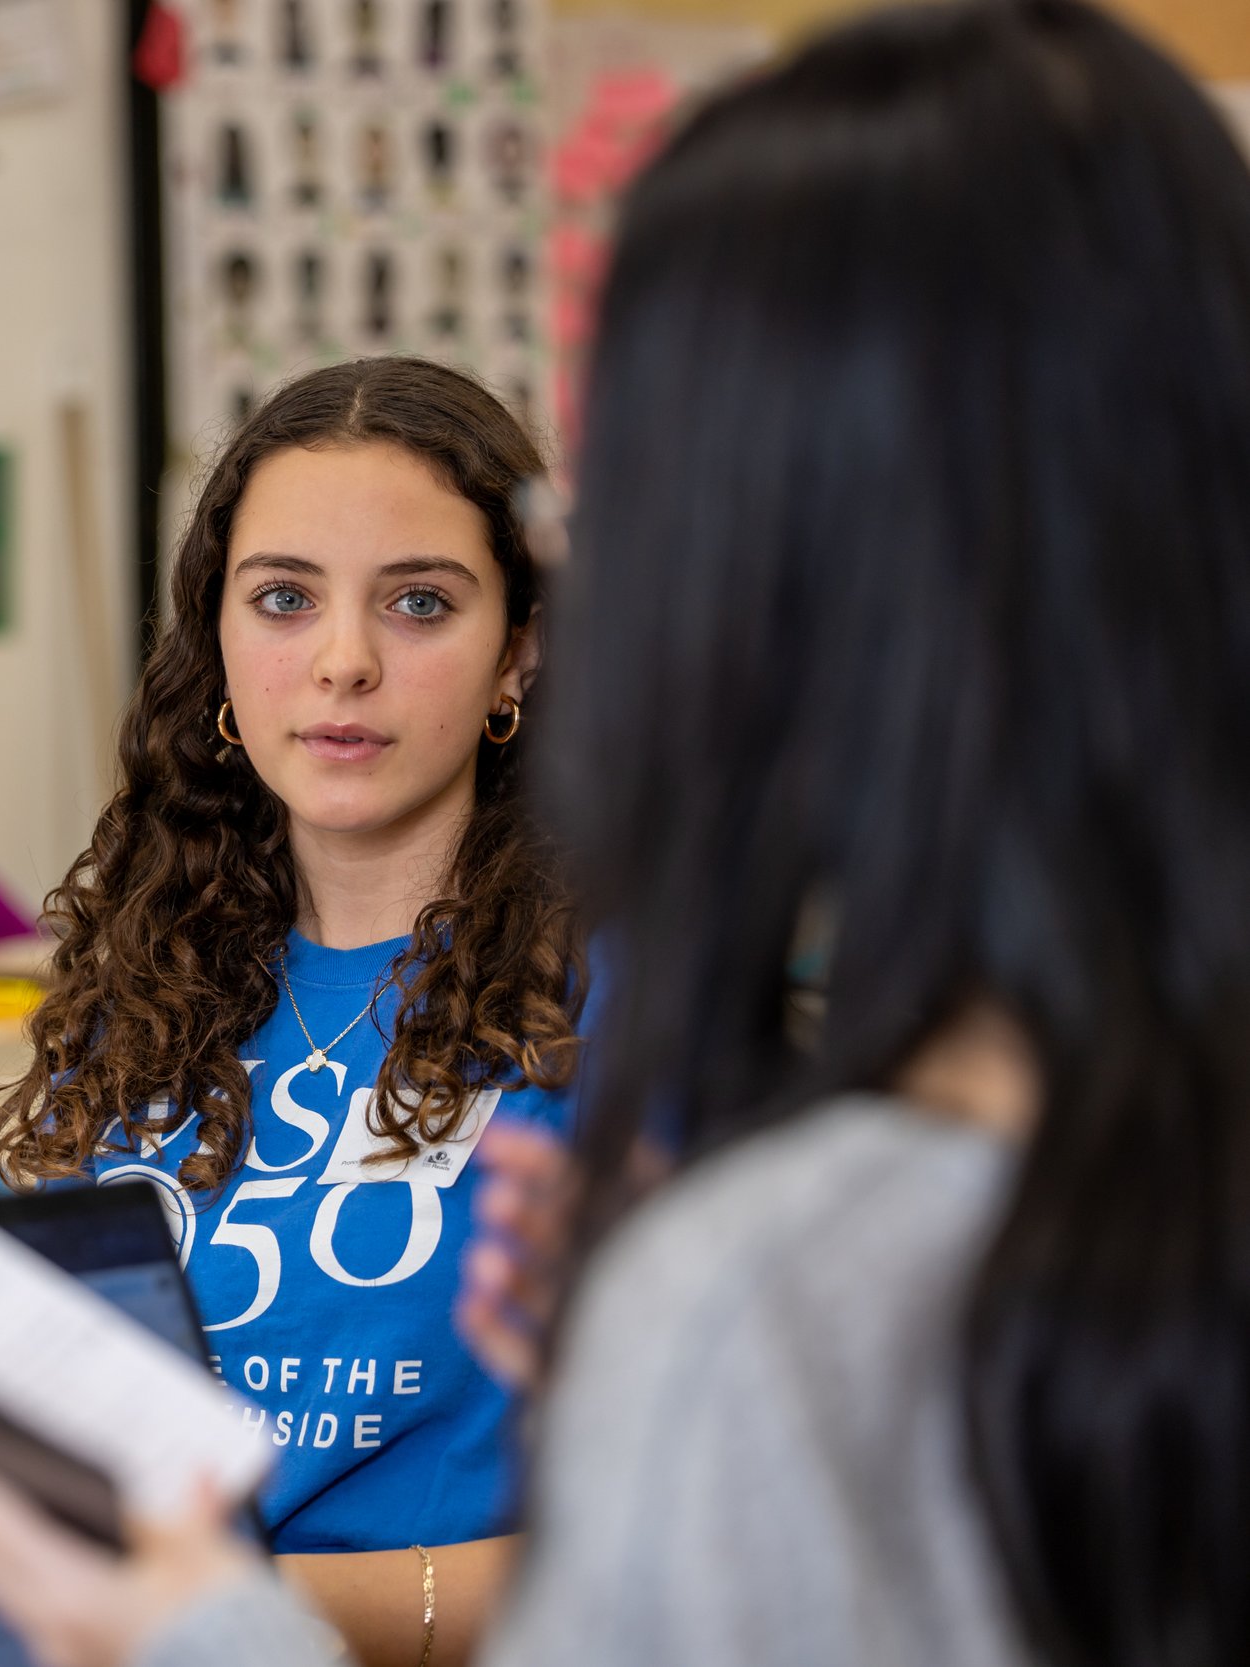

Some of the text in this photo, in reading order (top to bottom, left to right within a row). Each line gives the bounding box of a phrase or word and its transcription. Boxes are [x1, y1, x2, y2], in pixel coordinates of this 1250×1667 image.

[244, 1355, 301, 1392] OF
[322, 1357, 423, 1395] THE
[224, 1405, 382, 1448] HSIDE
